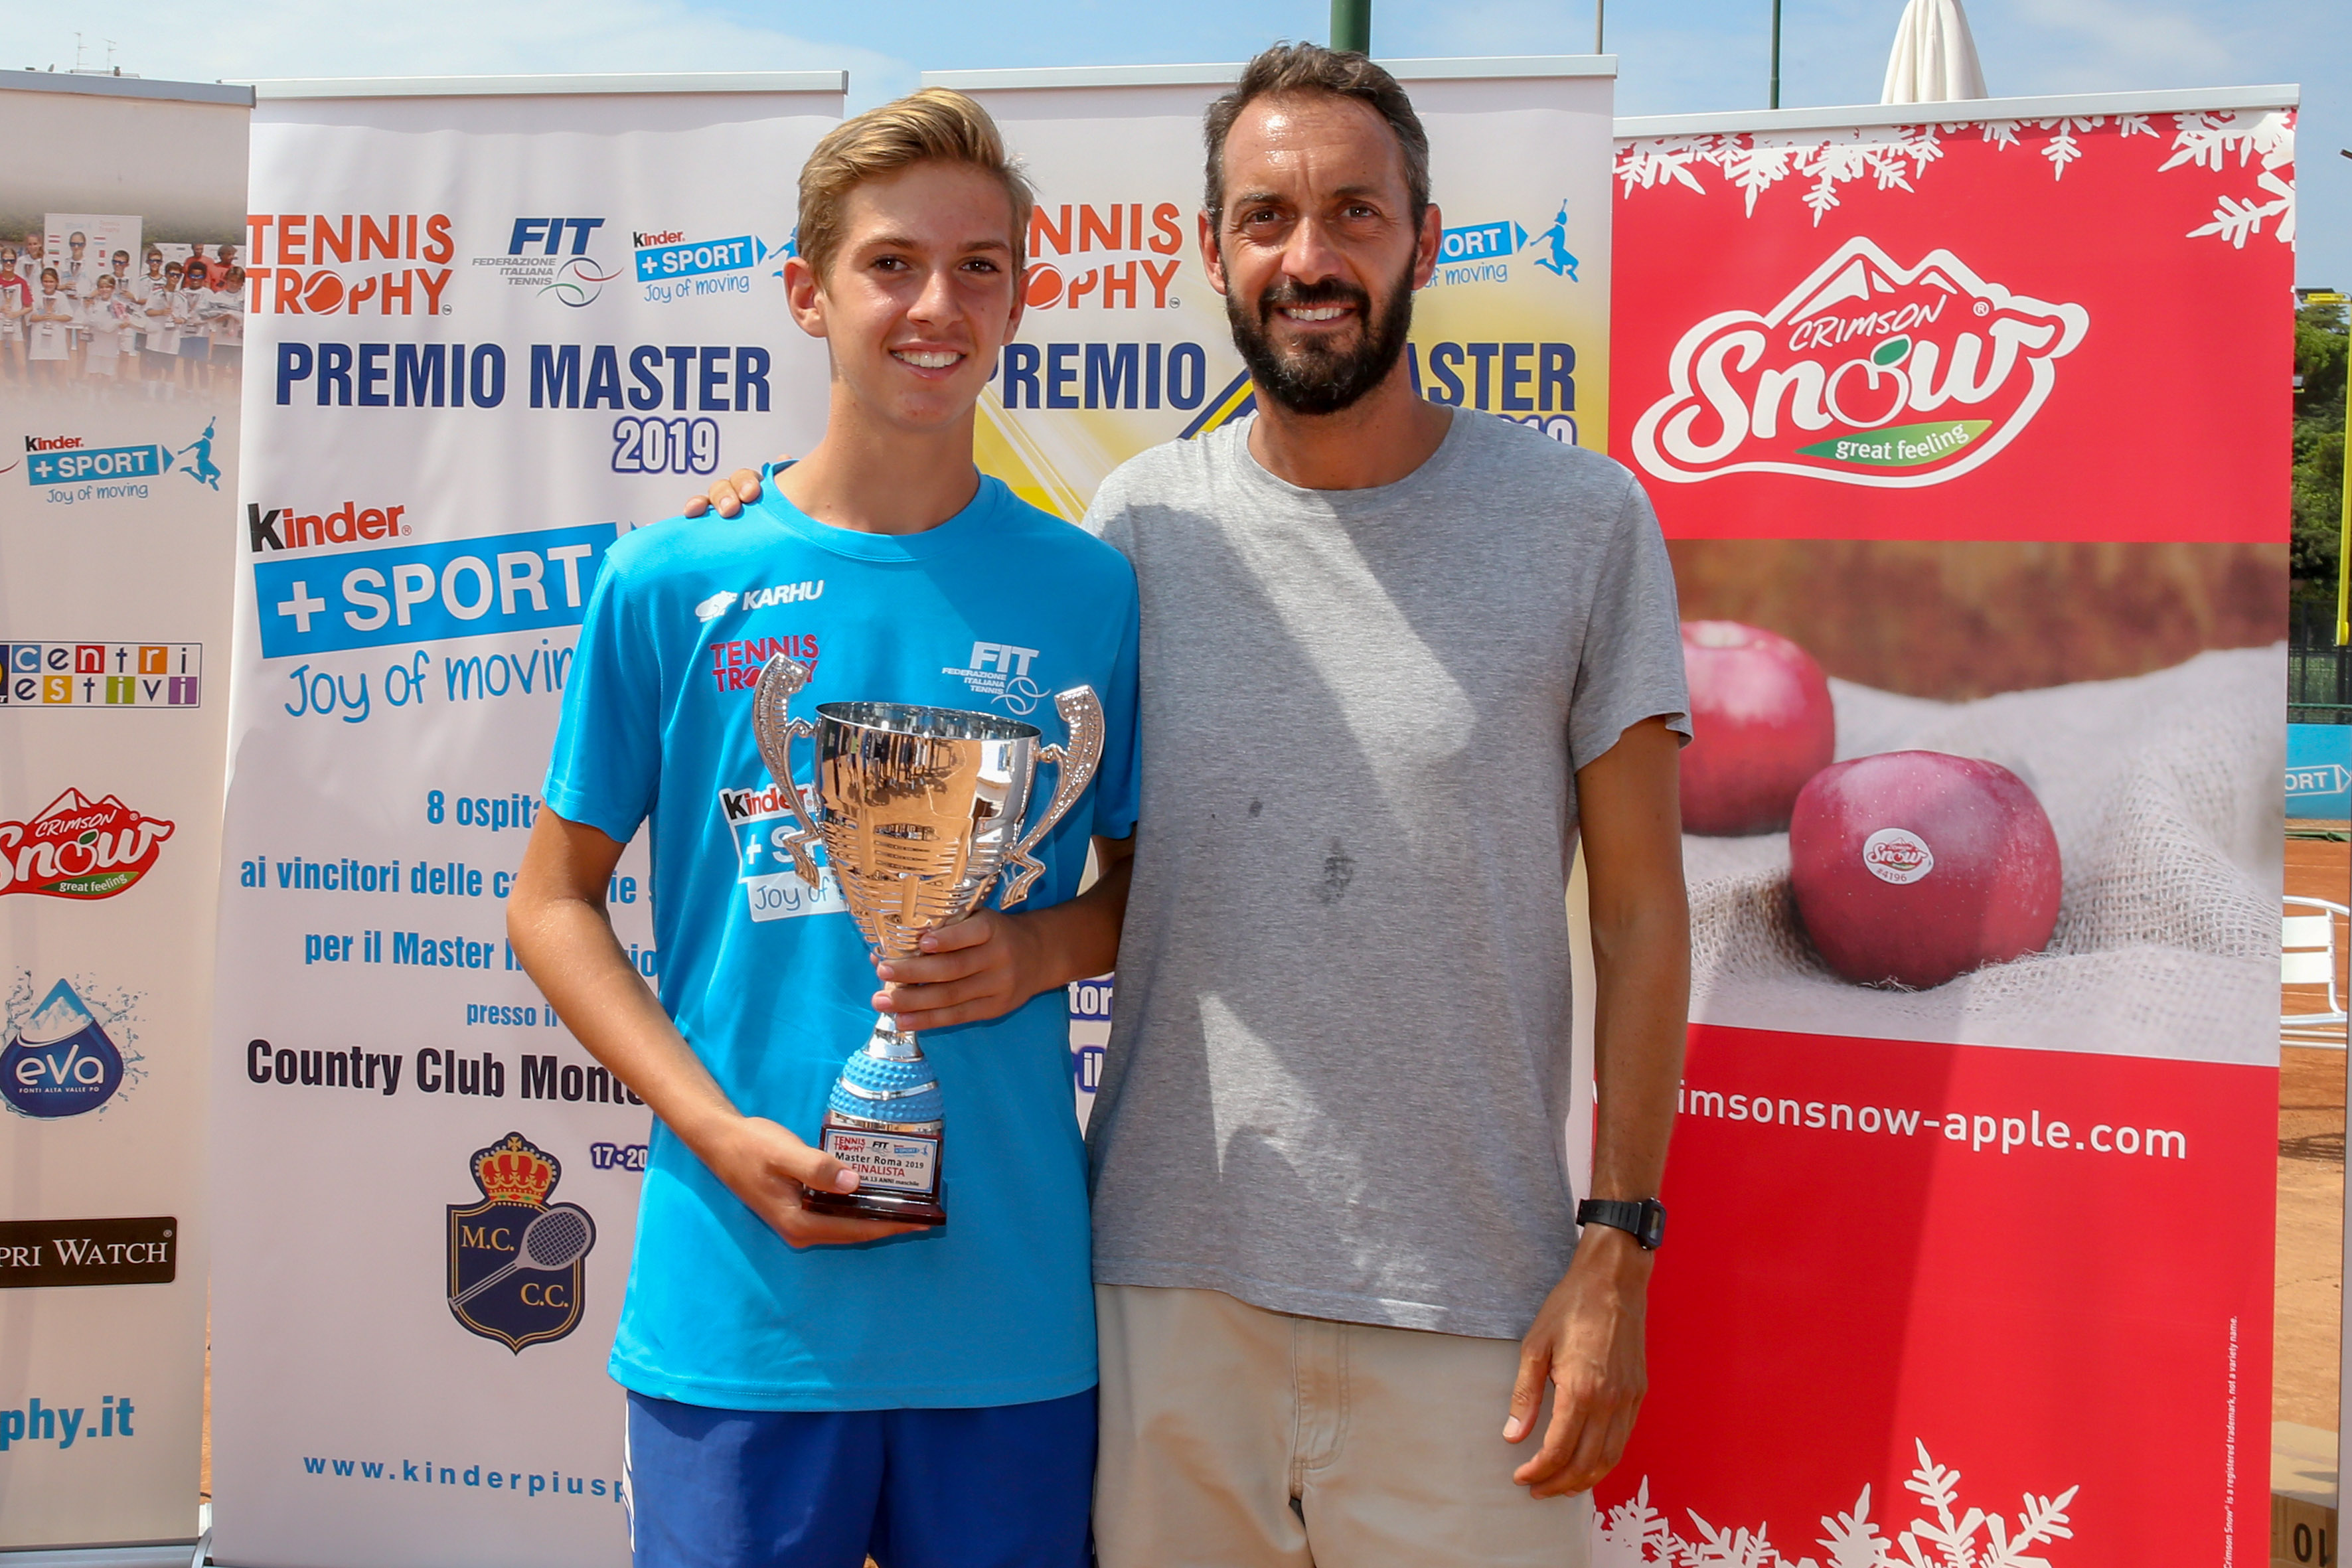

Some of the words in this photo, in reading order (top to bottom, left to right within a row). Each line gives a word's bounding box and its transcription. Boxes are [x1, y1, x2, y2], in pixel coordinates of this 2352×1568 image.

[246, 214, 455, 265] TENNIS
[507, 218, 605, 256] FIT
[1029, 202, 1183, 257] NNIS
[1443, 228, 1502, 258] ORT
[499, 268, 554, 276] ITALIANA
[662, 242, 745, 274] SPORT
[508, 277, 552, 286] TENNIS
[643, 284, 672, 303] Joy
[675, 279, 692, 297] of
[696, 274, 749, 296] moving
[1445, 262, 1508, 286] moving
[245, 268, 454, 315] TROPHY
[1788, 293, 1946, 352] CRIMSON
[275, 343, 507, 408] PREMIO
[530, 344, 772, 412] MASTER
[987, 342, 1206, 410] REMIO
[1661, 317, 2057, 464] Snow
[612, 416, 720, 475] 2019
[1834, 438, 1892, 461] great
[1897, 423, 1970, 461] feeling
[58, 450, 149, 477] SPORT
[46, 488, 74, 505] Joy
[77, 484, 93, 501] of
[96, 483, 148, 500] moving
[341, 544, 593, 632] SPORT
[742, 580, 824, 611] KARHU
[15, 647, 187, 673] centri
[710, 634, 819, 668] TENNIS
[969, 641, 1040, 676] FIT
[284, 665, 370, 724] Joy
[385, 650, 430, 706] of
[941, 667, 1007, 681] FEDERAZIONE
[964, 676, 1005, 688] ITALIANA
[15, 676, 189, 704] estivi
[970, 684, 1004, 695] TENNIS
[427, 790, 445, 824] 8
[35, 809, 117, 838] CRIMSON
[59, 882, 88, 892] great
[91, 874, 128, 892] feeling
[240, 856, 266, 888] ai
[277, 857, 400, 893] vincitori
[410, 862, 483, 898] delle
[754, 885, 801, 911] Joy
[305, 933, 353, 965] per
[363, 931, 382, 963] il
[393, 932, 495, 971] Master
[467, 1004, 536, 1026] presso
[247, 1039, 403, 1096] Country
[416, 1048, 505, 1098] Club
[1678, 1079, 2187, 1160] imsonsnow-apple.com
[834, 1135, 866, 1146] TENNIS
[834, 1142, 865, 1153] TROPHY
[872, 1140, 890, 1149] FIT
[835, 1152, 871, 1163] Master
[874, 1156, 902, 1166] Roma
[905, 1160, 924, 1169] 2019
[852, 1163, 905, 1177] FINALISTA
[461, 1225, 515, 1251] M.C.
[0, 1246, 42, 1267] PRI
[520, 1283, 570, 1307] C.C.
[2229, 1315, 2238, 1342] name.
[2227, 1342, 2238, 1372] variety
[2227, 1379, 2236, 1394] not
[0, 1395, 135, 1451] phy.it
[2226, 1395, 2237, 1443] trademark,
[2225, 1444, 2236, 1488] registered
[2225, 1496, 2234, 1504] is
[2223, 1534, 2233, 1568] Crimson
